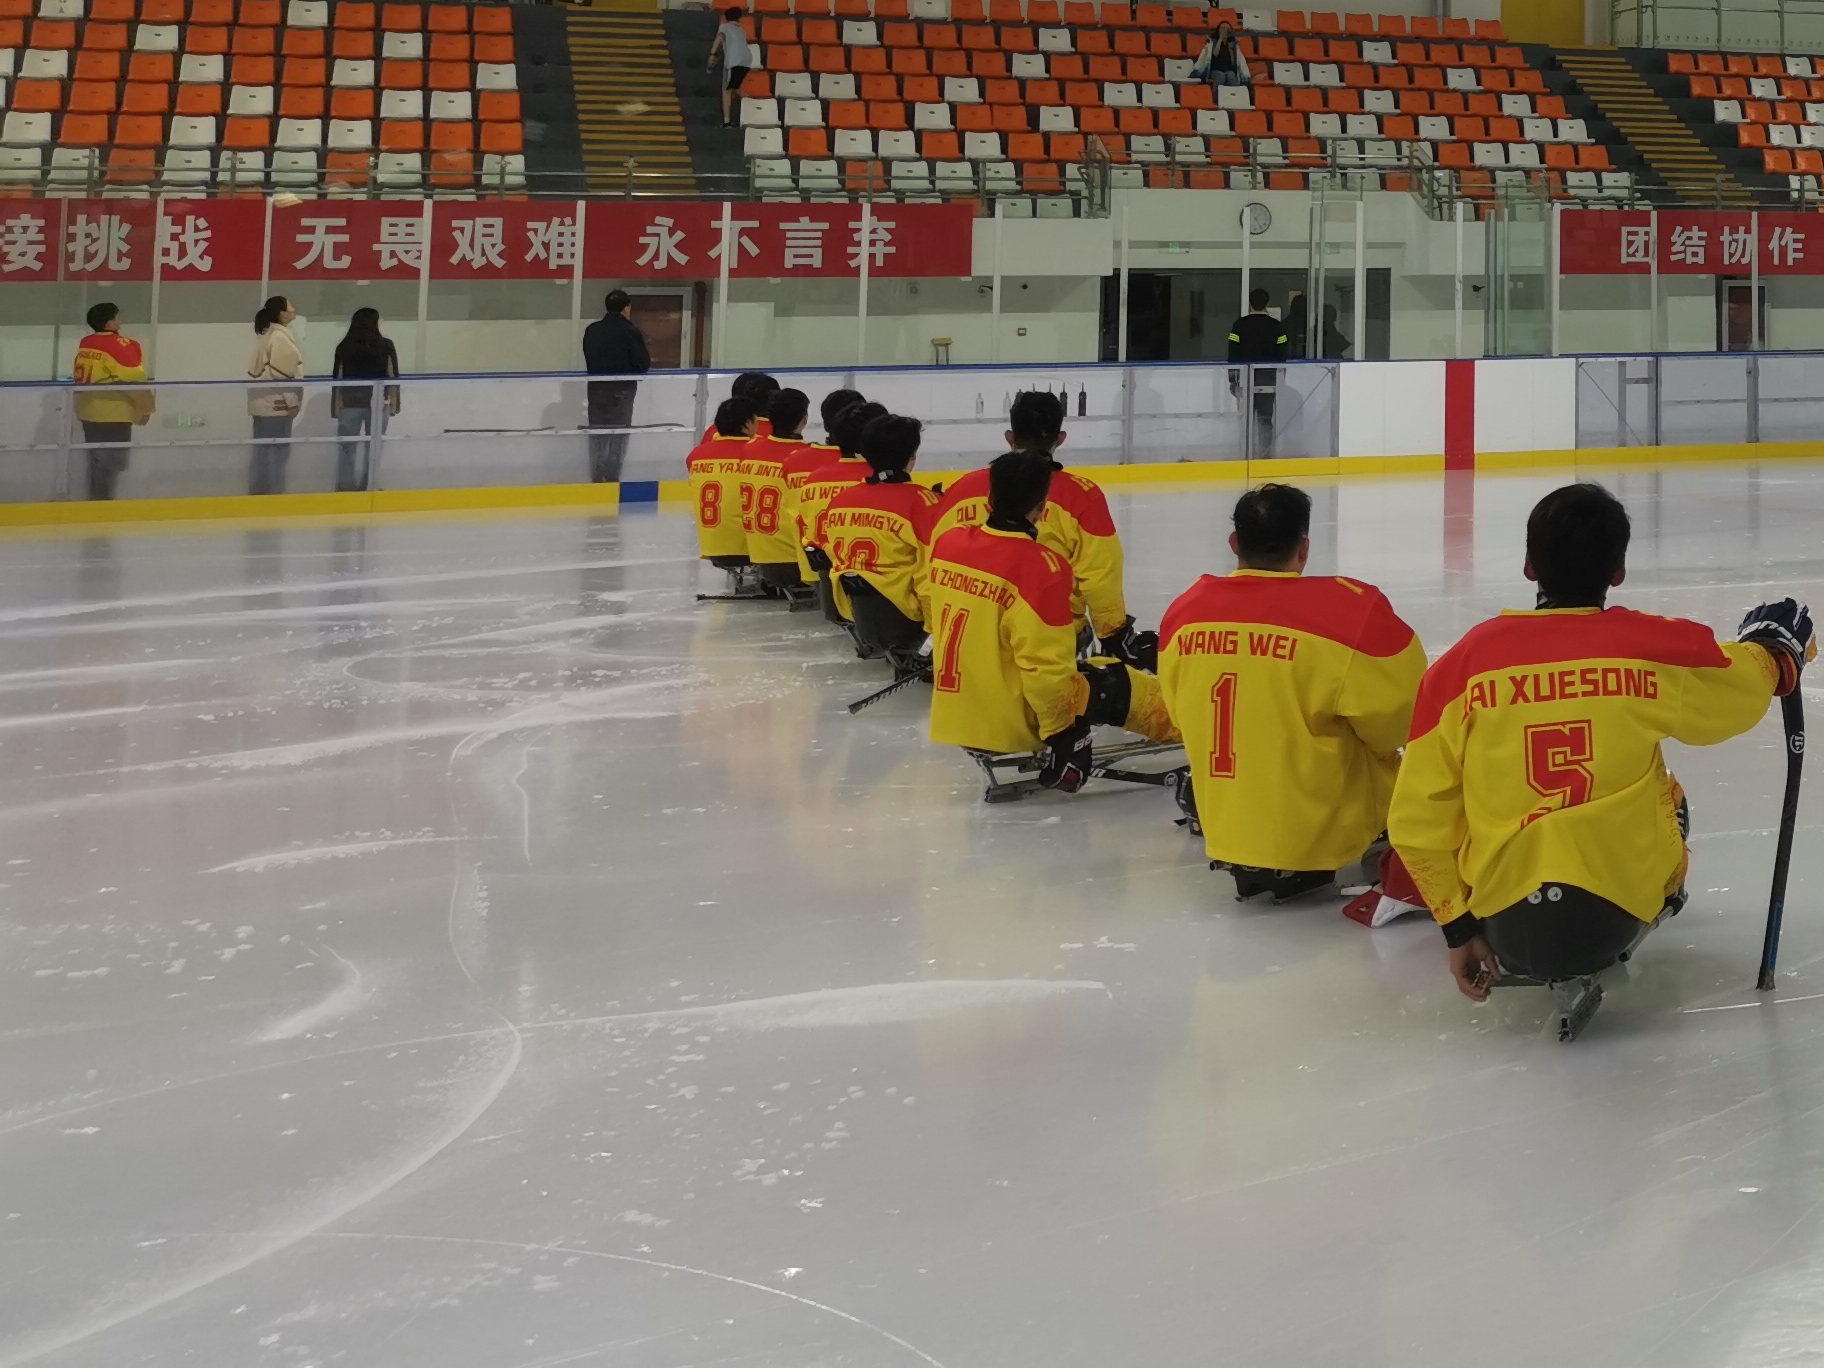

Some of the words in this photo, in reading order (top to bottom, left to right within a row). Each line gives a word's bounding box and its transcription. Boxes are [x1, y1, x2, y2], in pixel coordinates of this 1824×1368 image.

[0, 214, 213, 272] 接挑战
[292, 216, 581, 270] 无畏艰难
[635, 215, 896, 270] 永不言弃
[1619, 225, 1806, 266] 团结协作
[700, 480, 723, 528] 8
[819, 485, 849, 501] WE
[1177, 630, 1239, 657] WANG
[1248, 631, 1298, 662] WEI
[1464, 679, 1498, 716] AI
[1508, 667, 1658, 706] XUESONG
[1209, 672, 1238, 779] 1
[1520, 718, 1595, 829] 5
